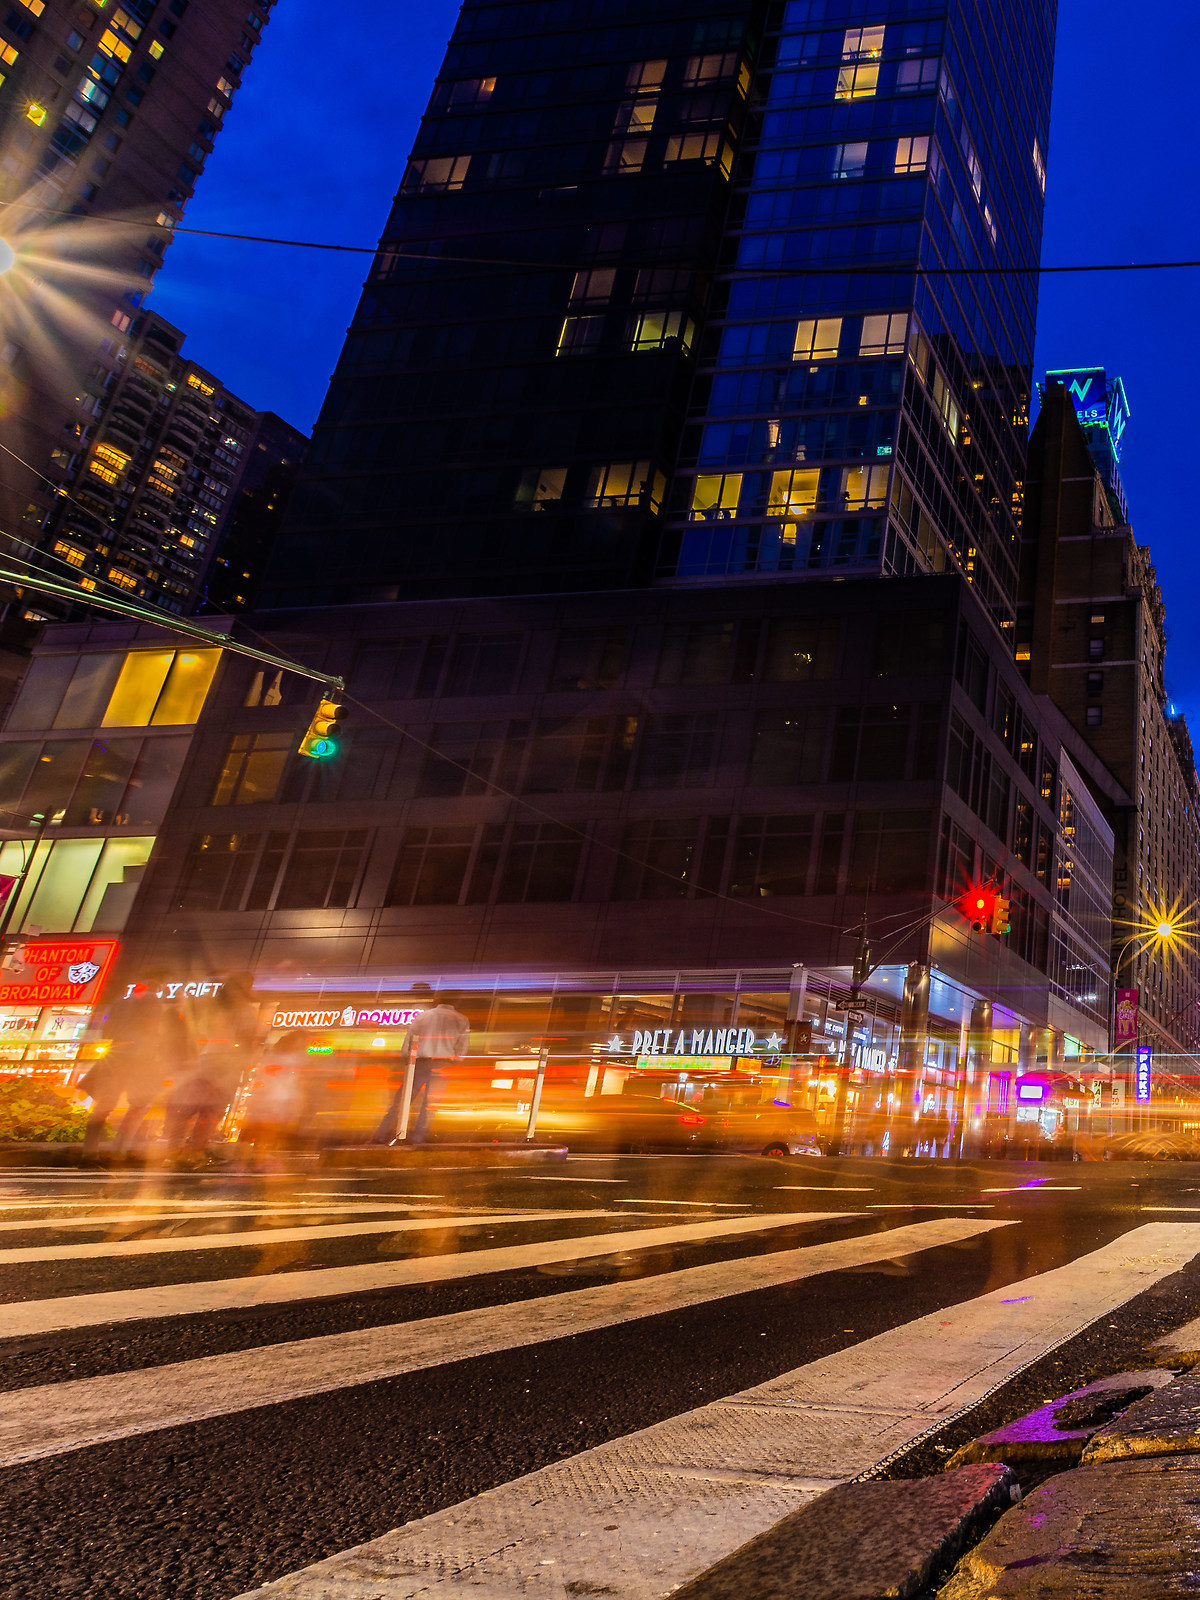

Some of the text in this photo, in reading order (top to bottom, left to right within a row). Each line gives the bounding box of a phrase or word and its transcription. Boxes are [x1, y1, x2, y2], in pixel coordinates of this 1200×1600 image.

[1077, 410, 1098, 418] ELS
[1113, 863, 1127, 918] HOTEL
[37, 967, 59, 982] OF
[0, 985, 83, 1001] BROADWAY
[183, 982, 224, 998] GIFT
[273, 1009, 424, 1027] DUNKIN' DONUTS
[631, 1028, 756, 1055] PRET A MANGER
